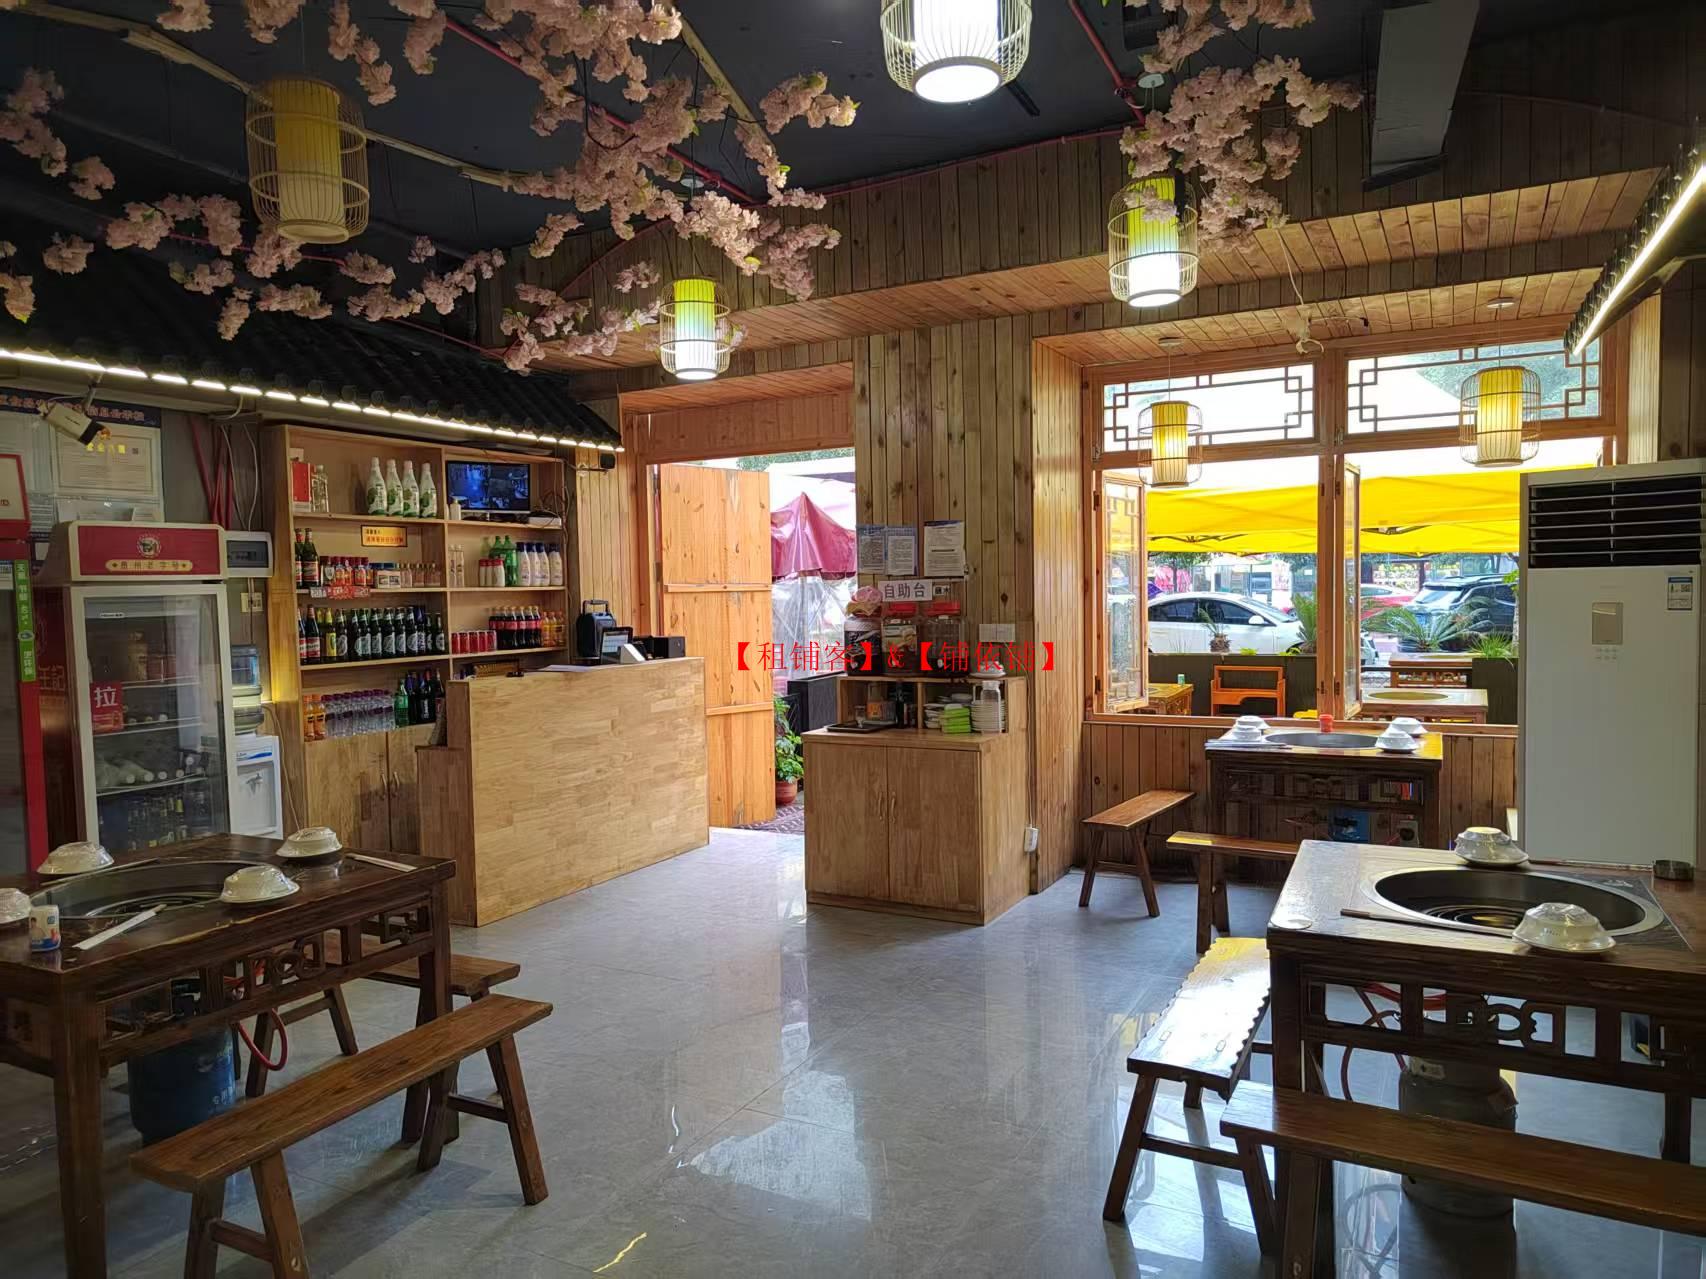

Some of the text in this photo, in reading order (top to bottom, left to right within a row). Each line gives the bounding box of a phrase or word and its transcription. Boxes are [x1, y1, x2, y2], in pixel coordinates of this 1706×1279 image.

[884, 582, 926, 599] 自助台
[93, 686, 119, 708] 拉
